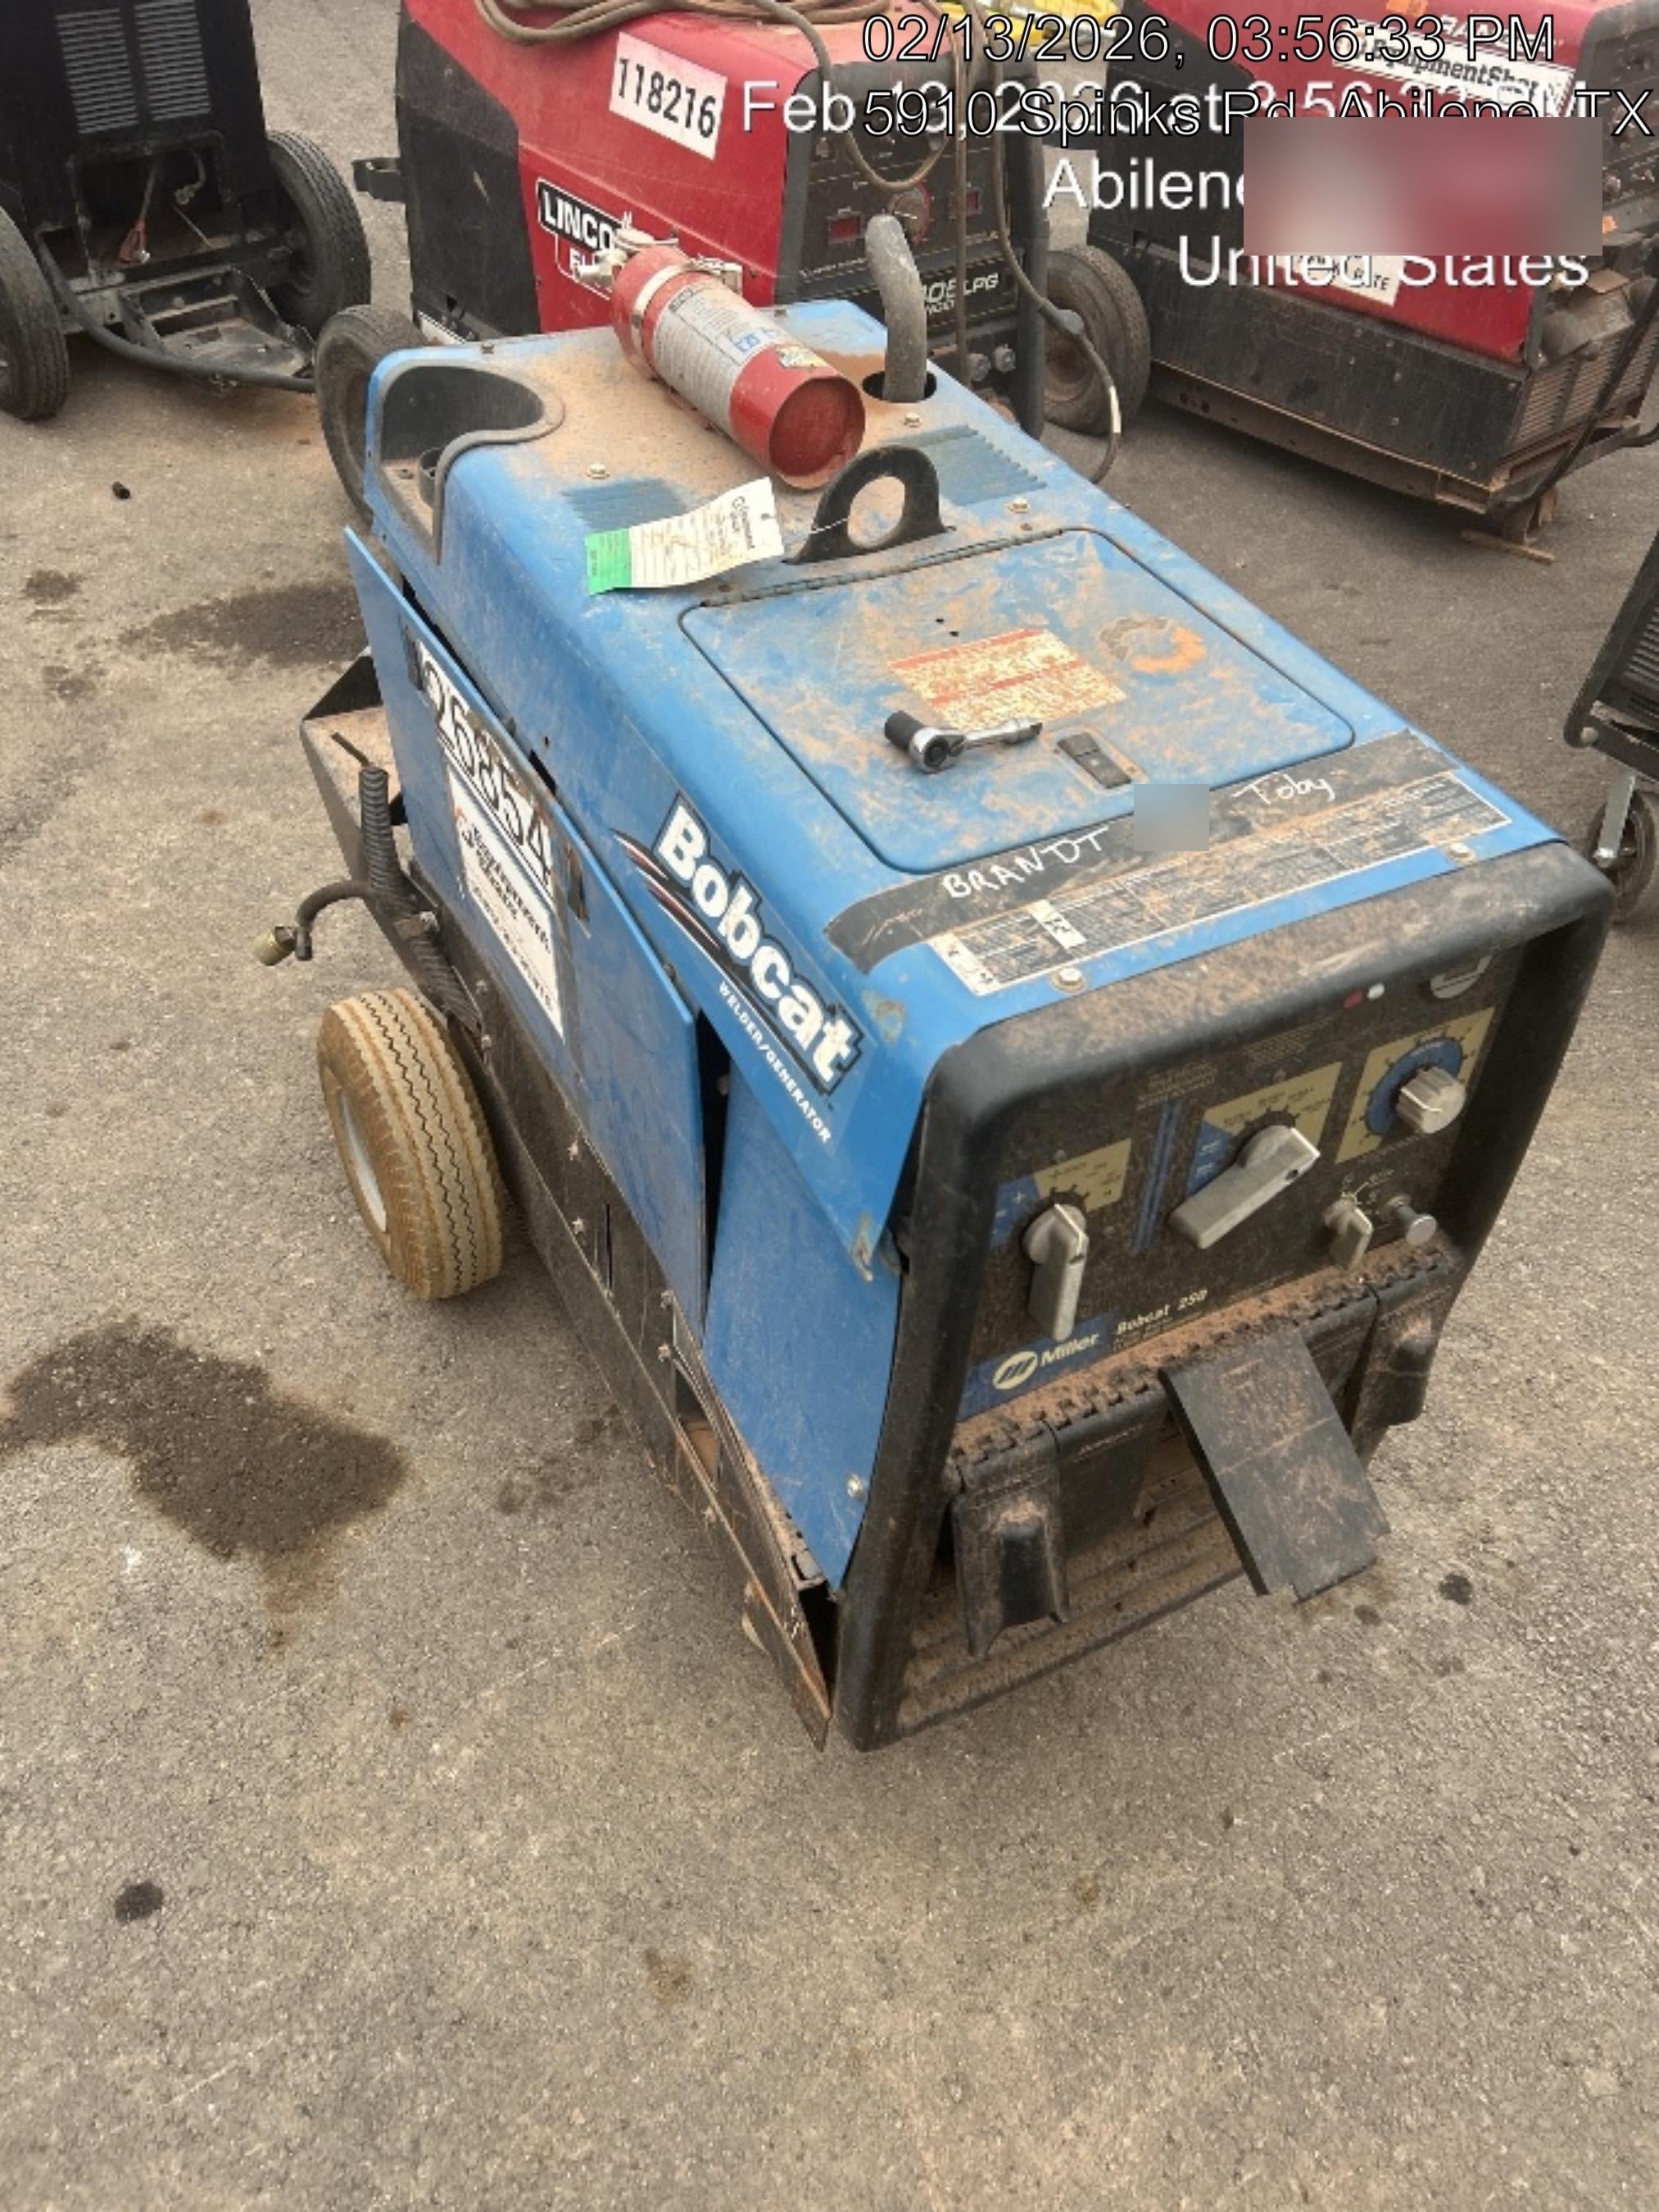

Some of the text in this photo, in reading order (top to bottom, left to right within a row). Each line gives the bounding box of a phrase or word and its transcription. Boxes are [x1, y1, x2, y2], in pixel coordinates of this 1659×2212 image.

[619, 58, 716, 138] 118216
[542, 188, 615, 251] LINCO
[1231, 772, 1336, 805] Toby
[942, 824, 1110, 899] BRANDT
[656, 804, 855, 1084] Bobcat
[718, 980, 832, 1144] WELDER/GENERATOR
[1040, 1332, 1100, 1367] Miller
